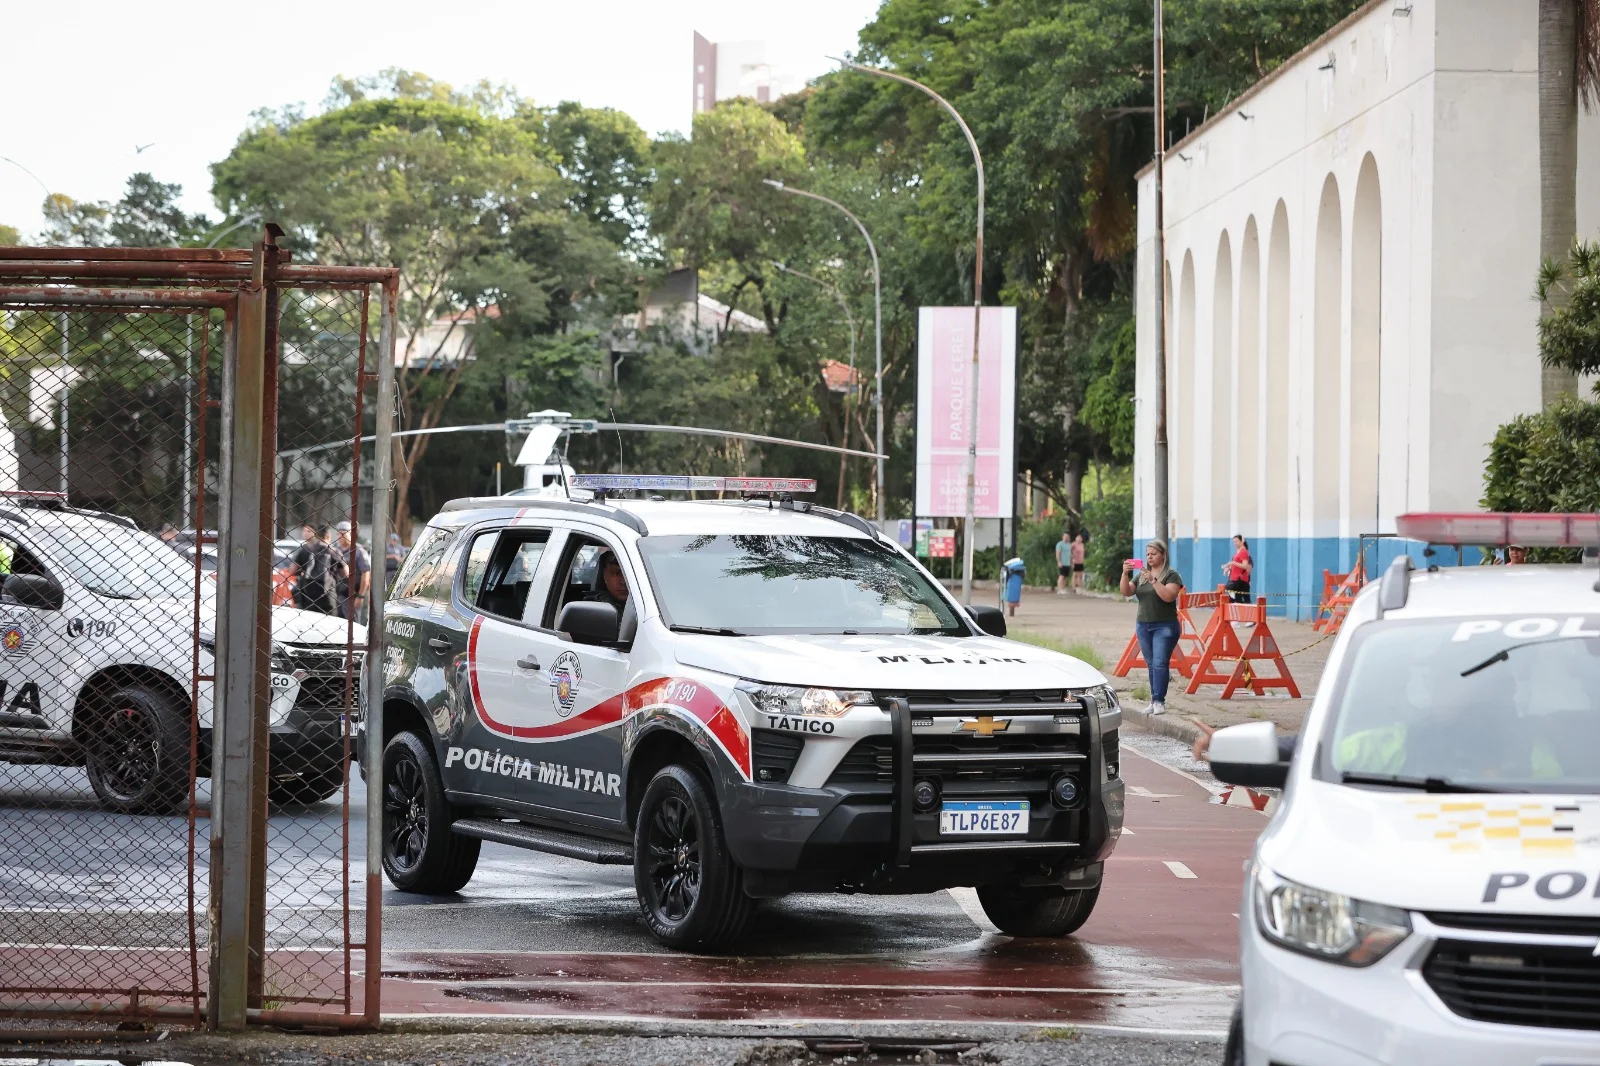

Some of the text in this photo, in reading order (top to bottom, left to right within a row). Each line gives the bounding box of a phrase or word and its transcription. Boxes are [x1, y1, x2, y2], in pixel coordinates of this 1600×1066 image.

[950, 327, 965, 441] PARQUE CERET
[86, 620, 117, 638] 190
[385, 619, 416, 639] M-08020
[674, 682, 697, 704] 190
[767, 715, 835, 735] TÁTICO
[444, 746, 532, 781] POLÍCIA
[537, 760, 622, 798] MILITAR
[950, 813, 1021, 832] TLP6E87
[1481, 870, 1600, 904] PO
